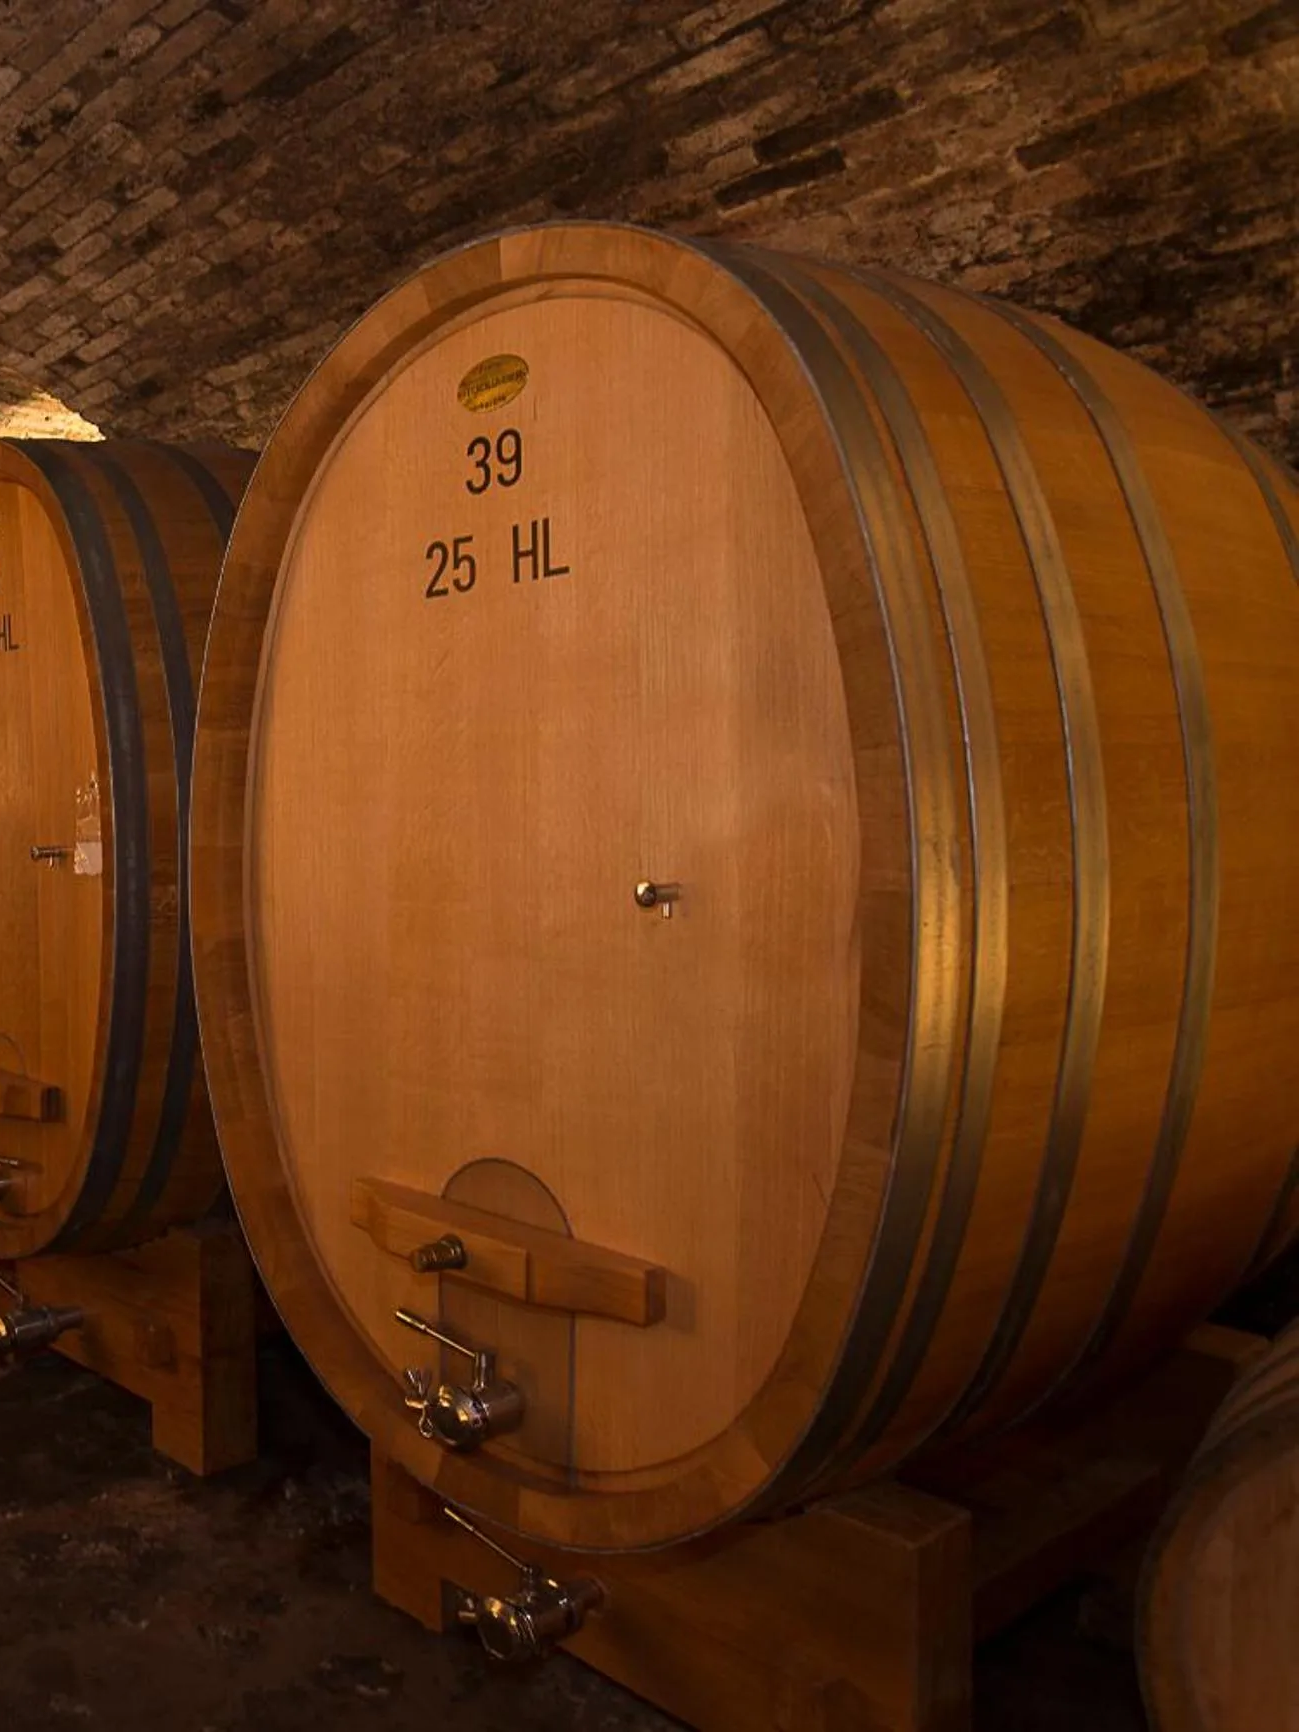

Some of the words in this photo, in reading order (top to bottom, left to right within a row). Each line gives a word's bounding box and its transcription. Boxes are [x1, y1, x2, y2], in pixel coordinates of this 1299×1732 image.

[465, 428, 522, 495] 39
[425, 534, 477, 599] 25
[512, 517, 570, 583] HL
